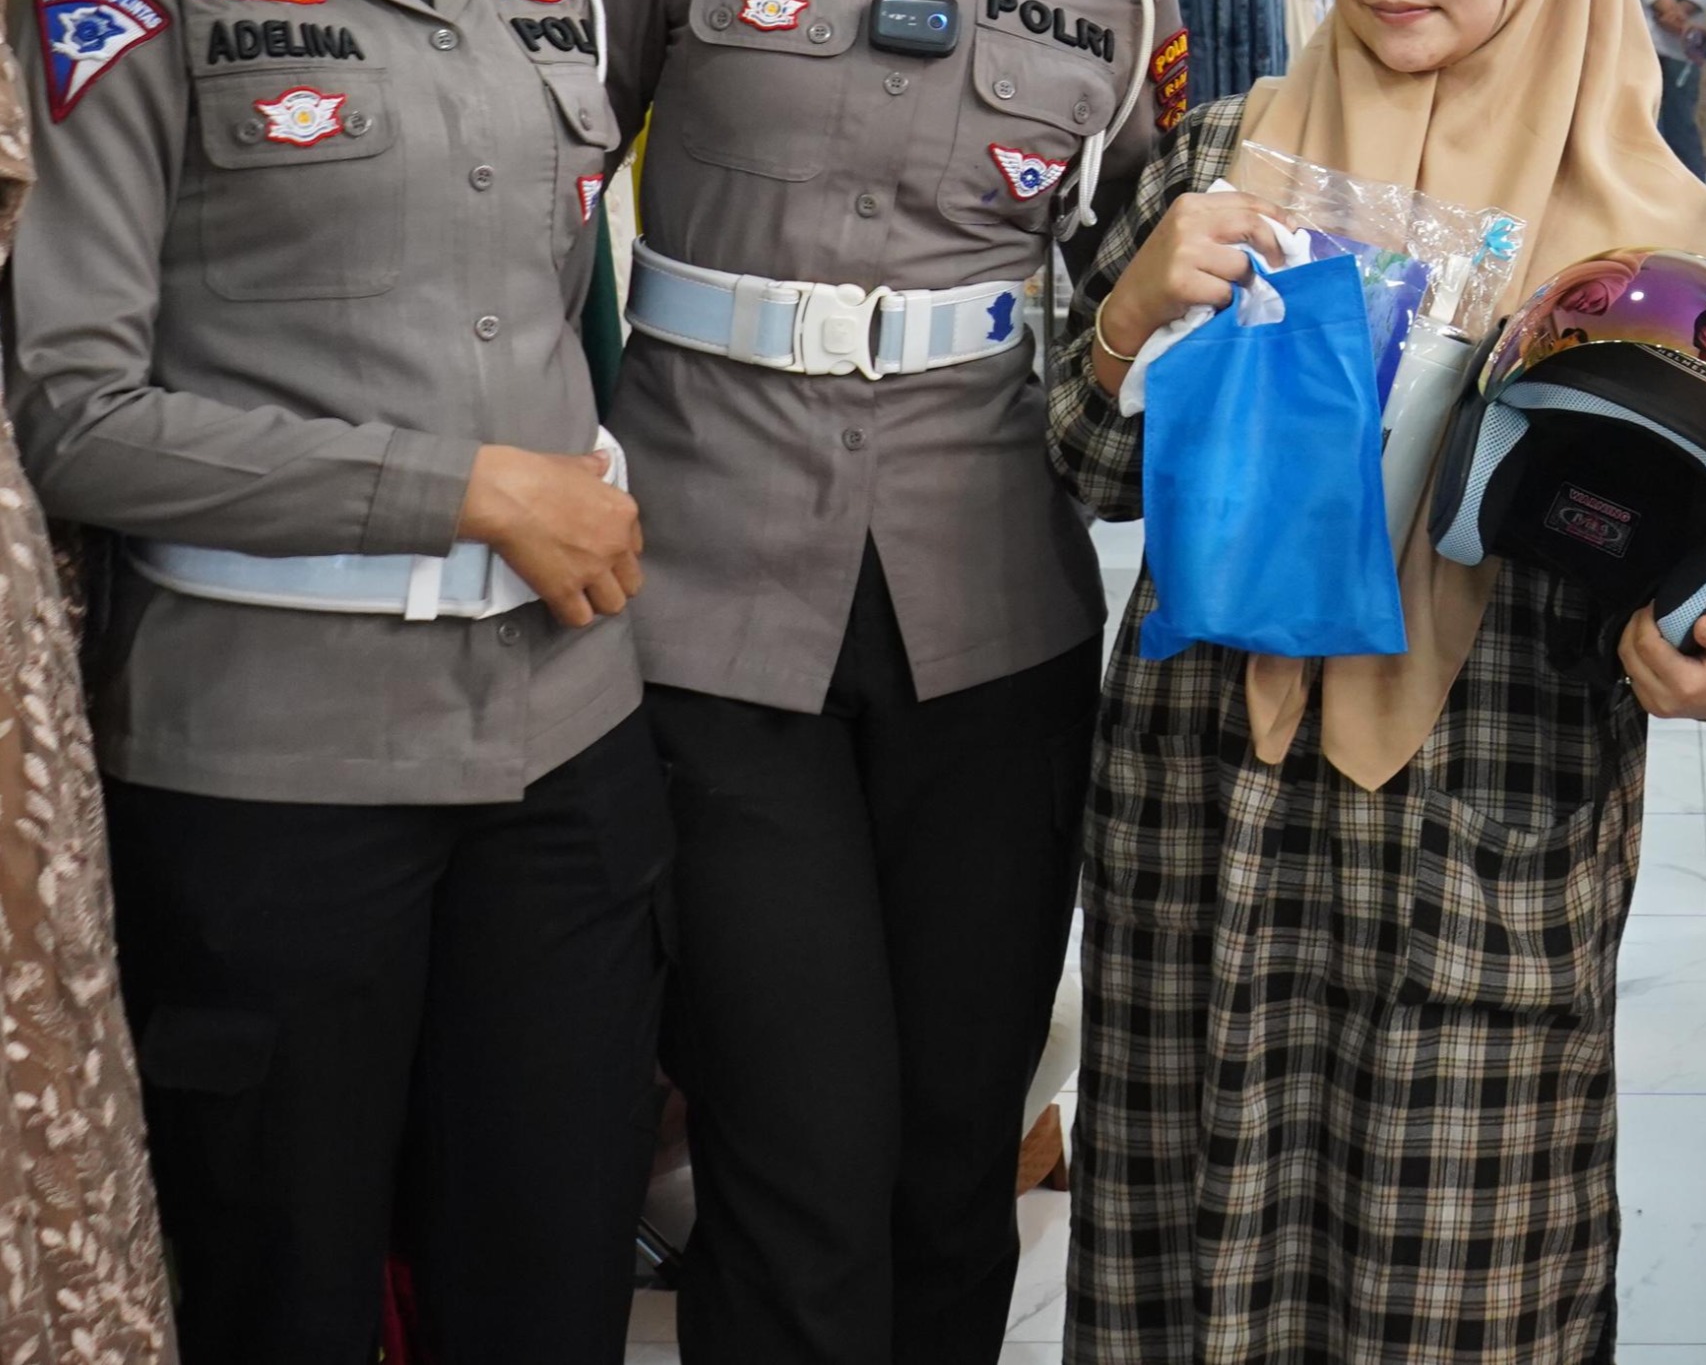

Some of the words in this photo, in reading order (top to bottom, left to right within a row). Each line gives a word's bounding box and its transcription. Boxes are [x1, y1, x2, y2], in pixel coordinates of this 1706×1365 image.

[208, 20, 365, 65] ADELINA
[1658, 348, 1706, 375] HELMET
[1569, 488, 1631, 523] WARNING
